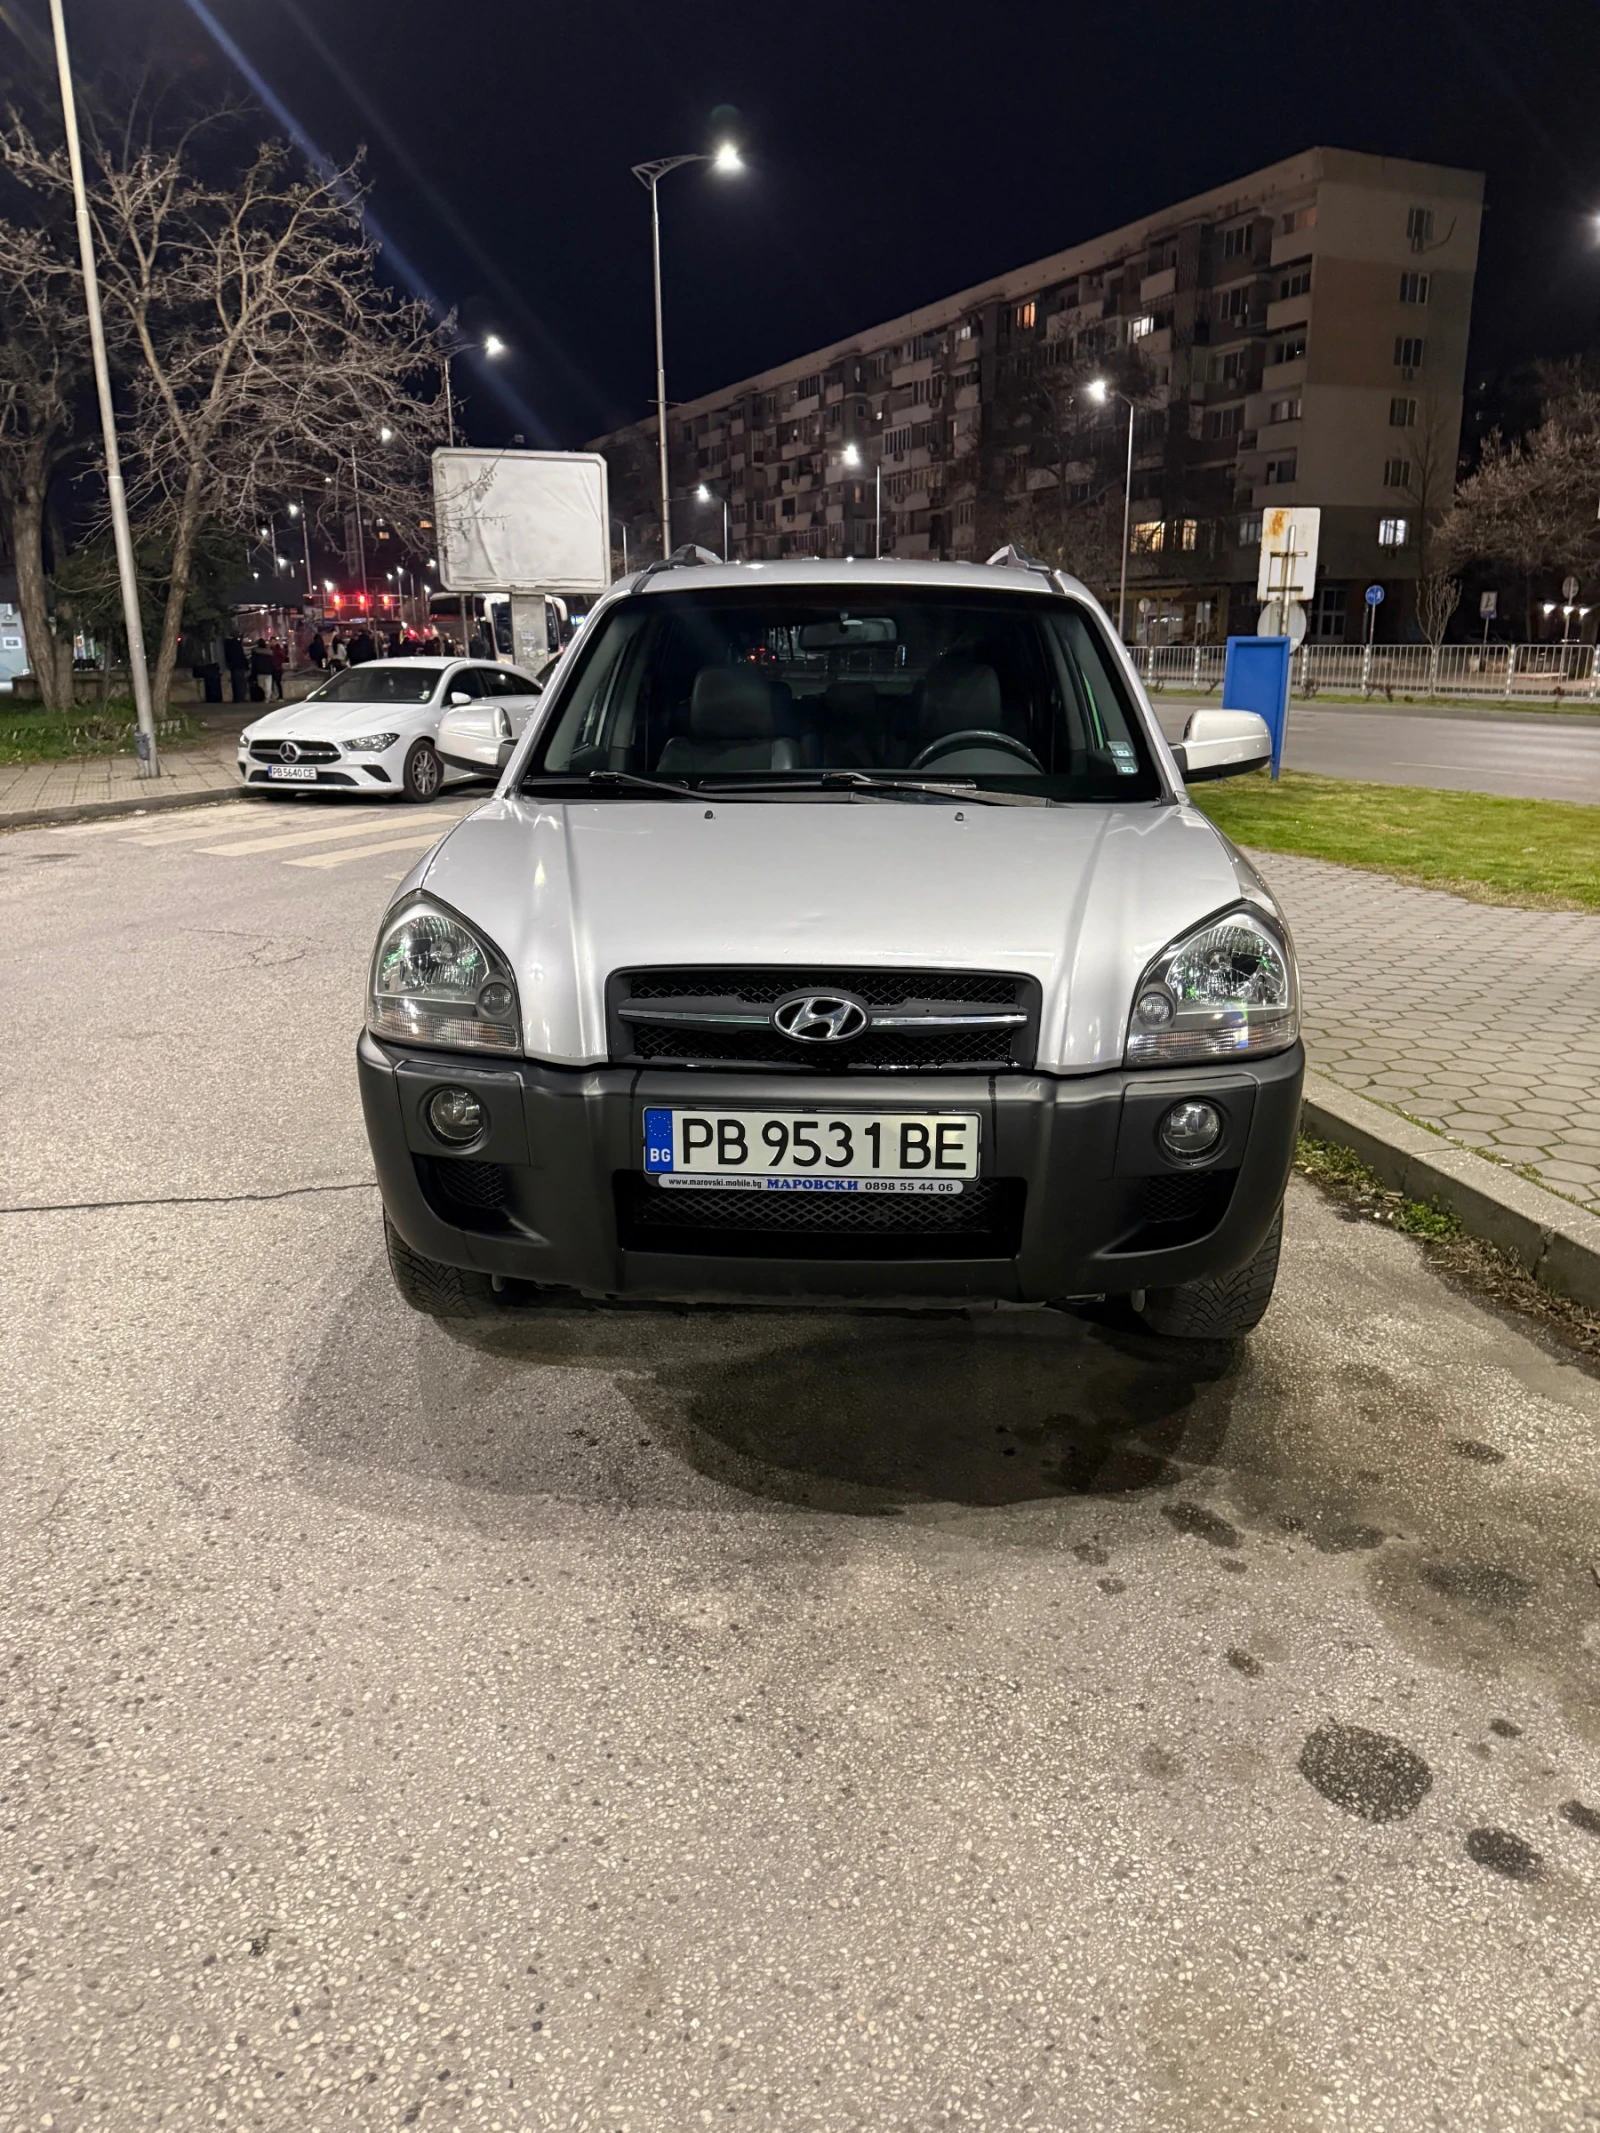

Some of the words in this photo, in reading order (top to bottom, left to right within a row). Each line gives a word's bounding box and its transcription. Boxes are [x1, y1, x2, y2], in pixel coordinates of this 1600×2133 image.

[682, 1118, 748, 1165] PB
[761, 1121, 881, 1169] 9531
[900, 1122, 966, 1170] BE
[650, 1148, 671, 1163] BG
[668, 1178, 762, 1189] www.marovski.mobile.bg
[766, 1179, 859, 1191] МАРОВСКИ
[864, 1182, 896, 1191] 0898
[900, 1183, 915, 1191] 55
[918, 1183, 934, 1191] 44
[938, 1183, 953, 1192] 06
